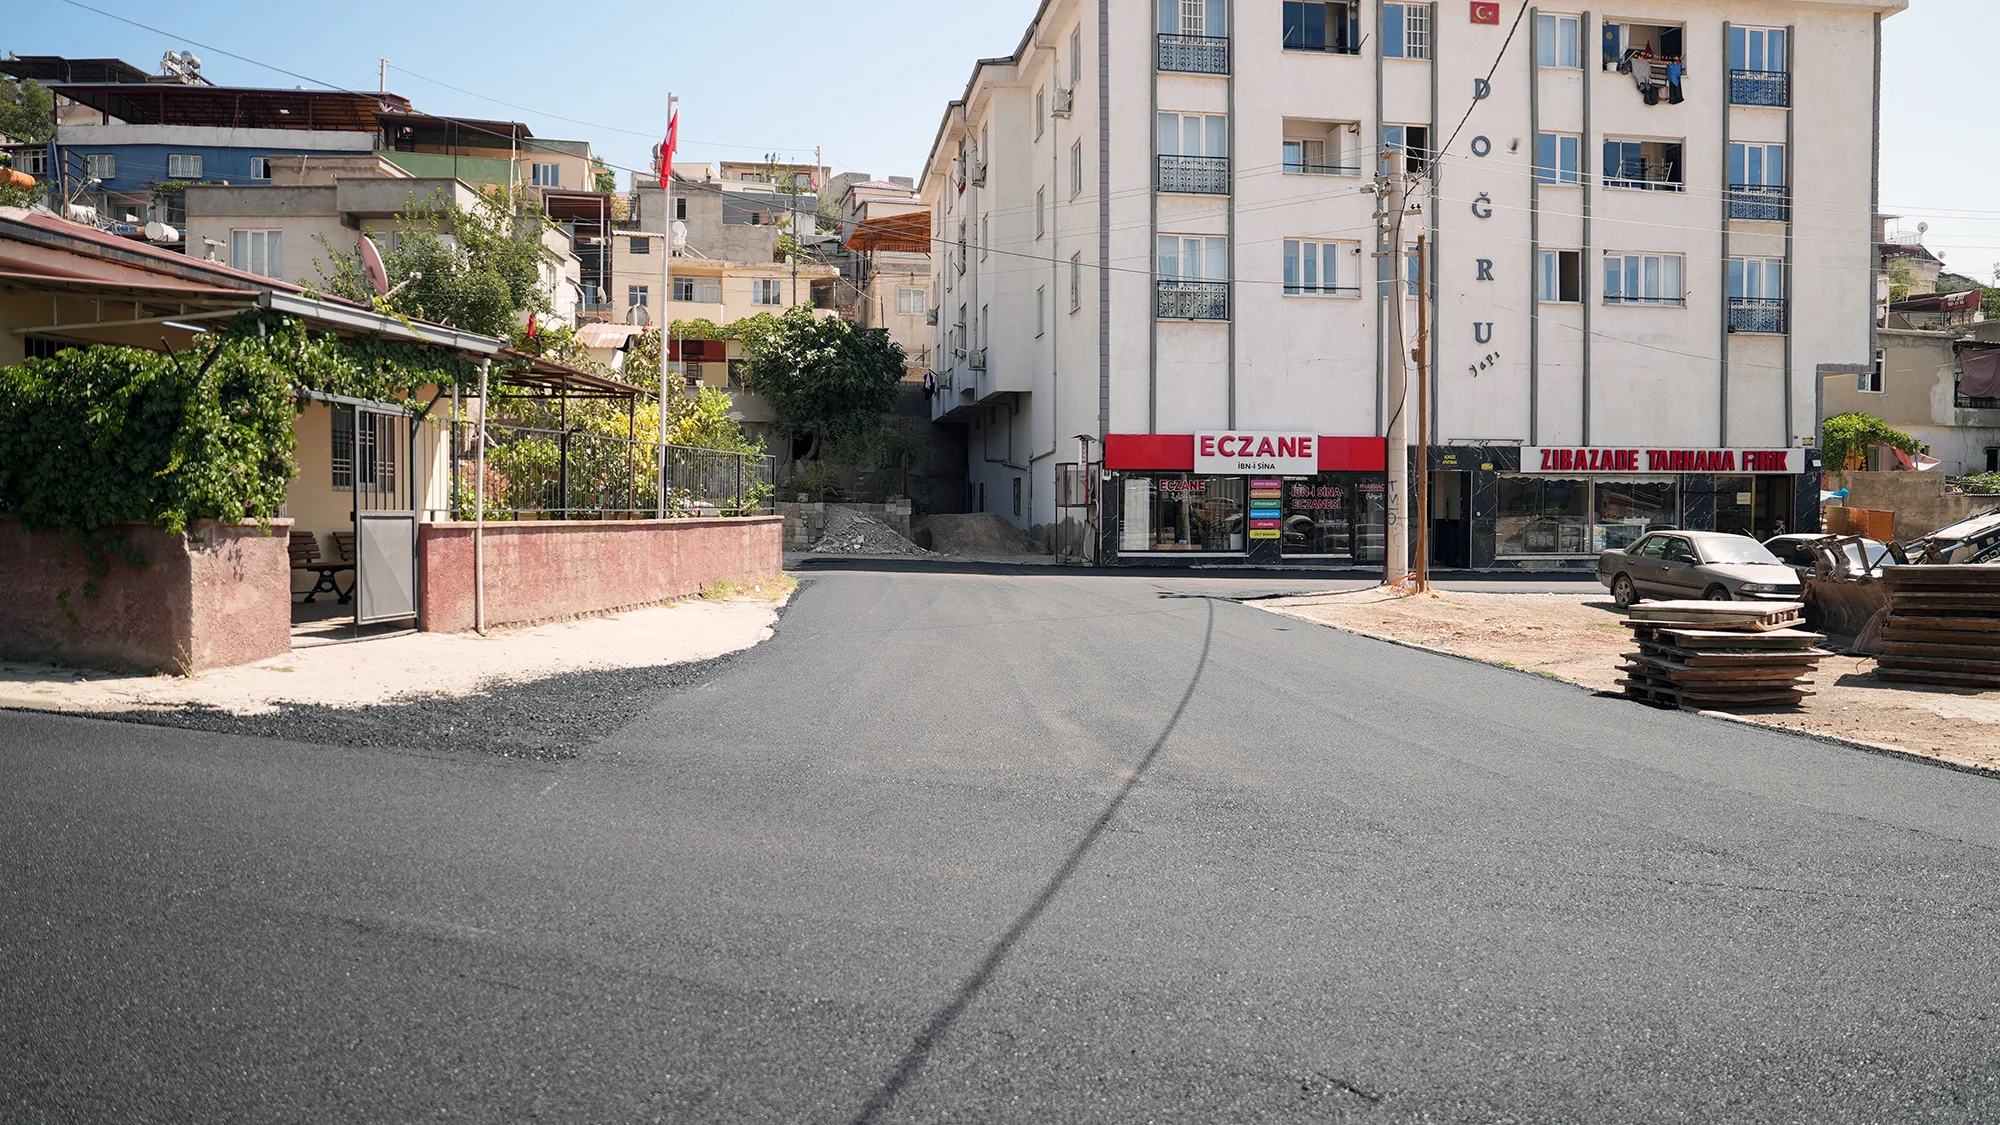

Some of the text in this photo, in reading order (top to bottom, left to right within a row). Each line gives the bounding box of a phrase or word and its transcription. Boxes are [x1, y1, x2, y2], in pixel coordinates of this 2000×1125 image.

[1200, 435, 1313, 458] ECZANE
[1257, 461, 1276, 470] SİNA
[1540, 449, 1640, 471] ZIBAZADE
[1646, 450, 1736, 471] TARHANA
[1159, 479, 1206, 491] ECZANE
[1317, 485, 1342, 498] SİNA
